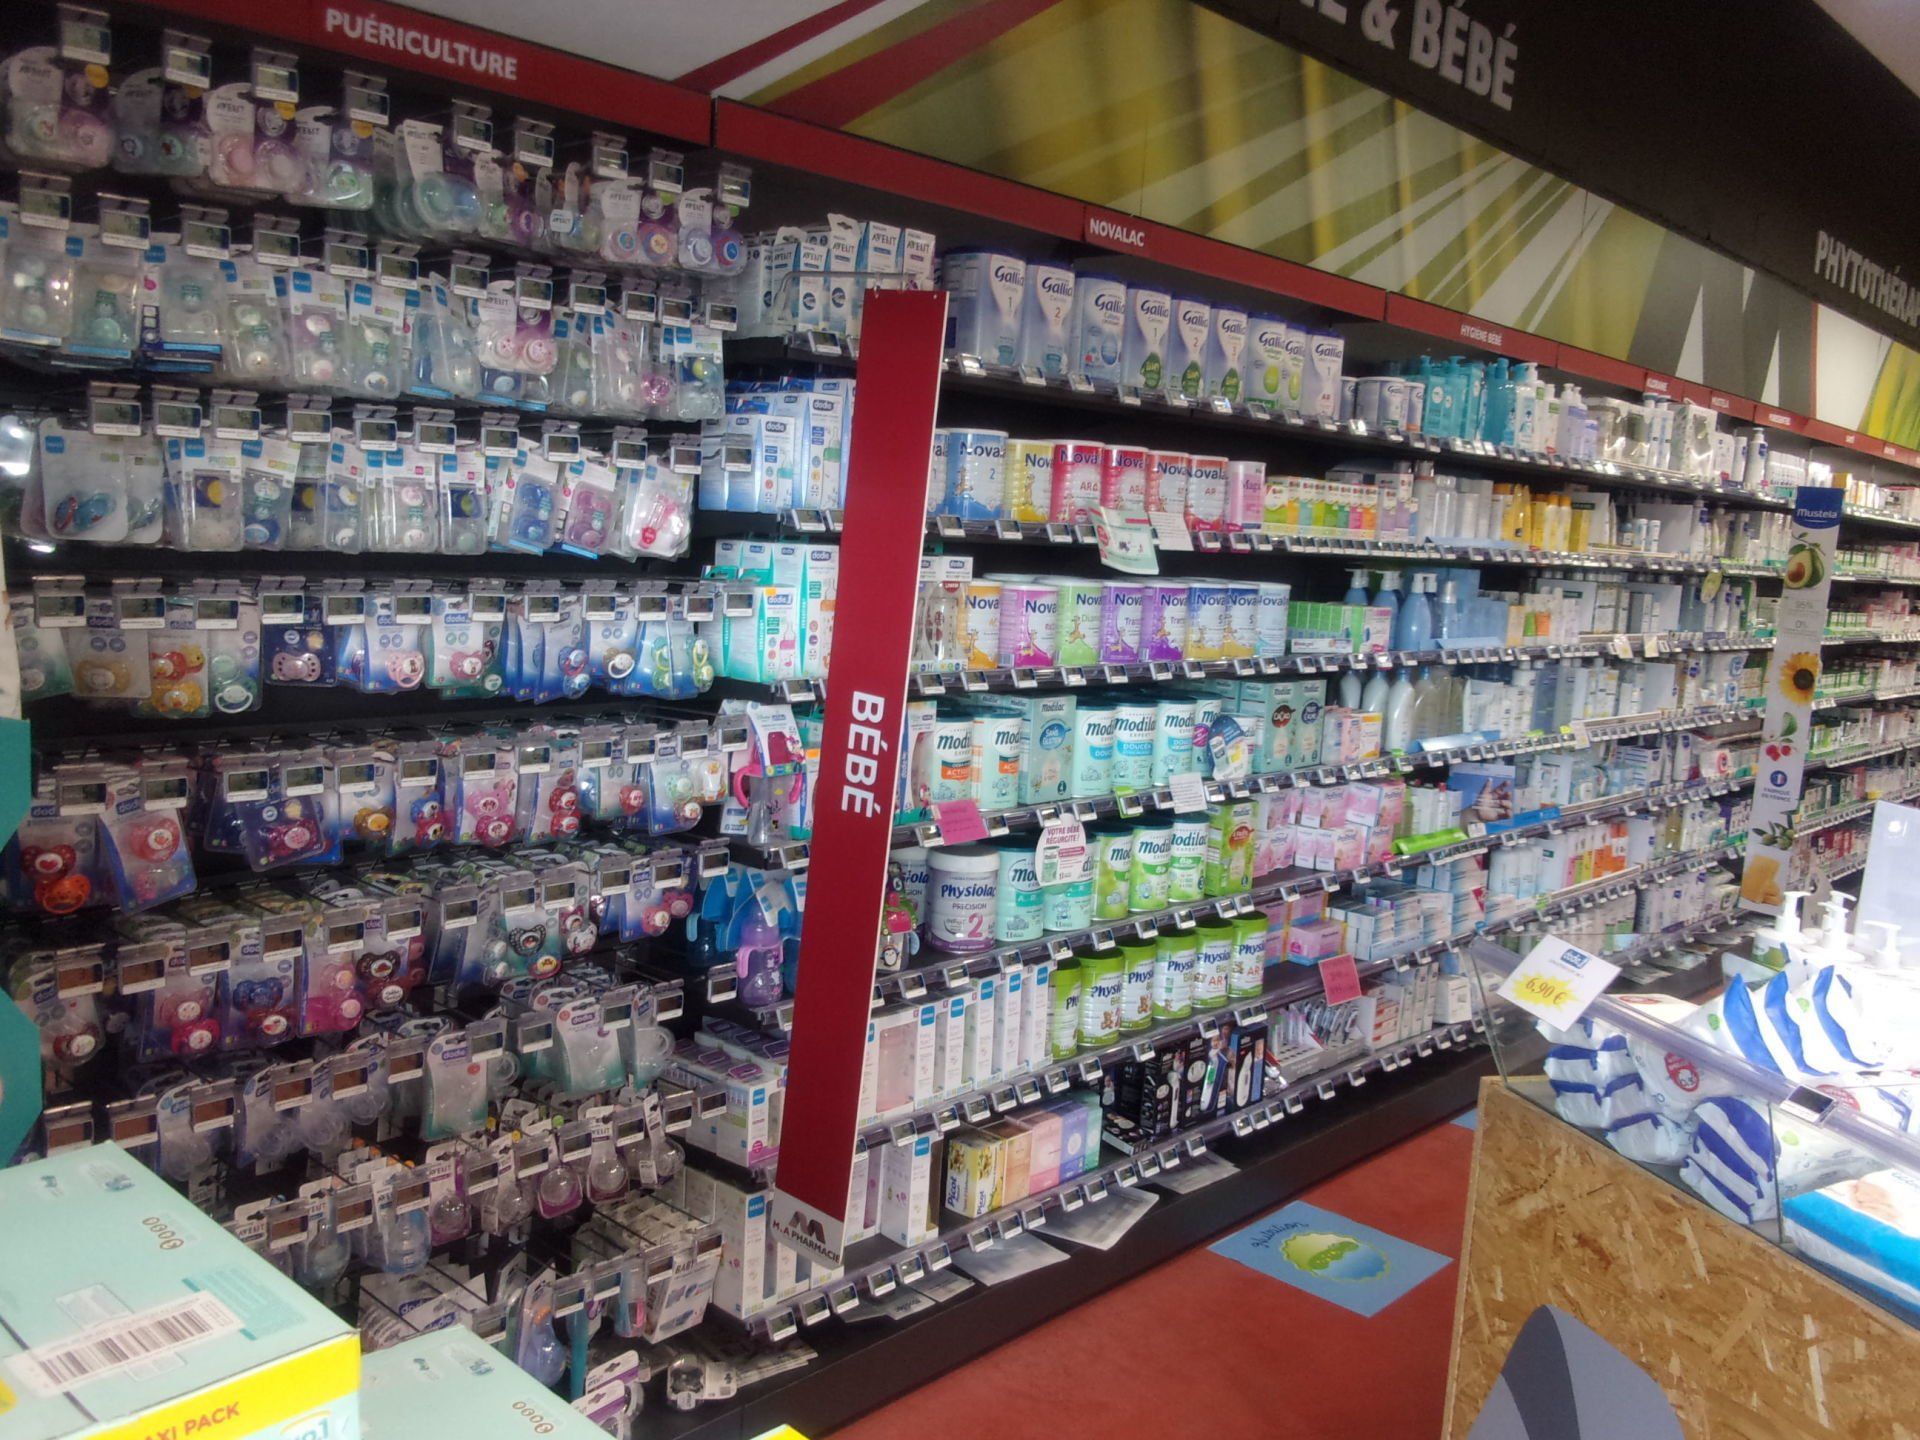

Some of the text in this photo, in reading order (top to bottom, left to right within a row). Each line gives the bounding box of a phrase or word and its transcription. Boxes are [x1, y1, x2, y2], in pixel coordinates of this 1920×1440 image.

[325, 8, 518, 81] PUÉRICULTURE
[1409, 0, 1518, 111] BÉBÉ
[1090, 218, 1145, 247] NOVALAC
[994, 265, 1025, 286] Gallia
[1815, 230, 1920, 327] PHYTOTHÉRA
[1042, 277, 1072, 296] Gallia
[1008, 296, 1012, 310] 1
[1054, 307, 1060, 318] 2
[1094, 294, 1126, 314] Gallia
[1141, 300, 1169, 316] Gallia
[1183, 310, 1208, 327] Gallia
[1193, 336, 1198, 347] 2
[1316, 343, 1342, 358] Gallia
[990, 468, 995, 479] 2
[1797, 508, 1837, 519] Mustela
[841, 691, 888, 817] BÉBÉ
[968, 913, 983, 939] 2
[1526, 978, 1566, 1005] 6,90 €
[790, 1231, 840, 1262] PHARMACIE
[184, 1401, 241, 1435] PACK
